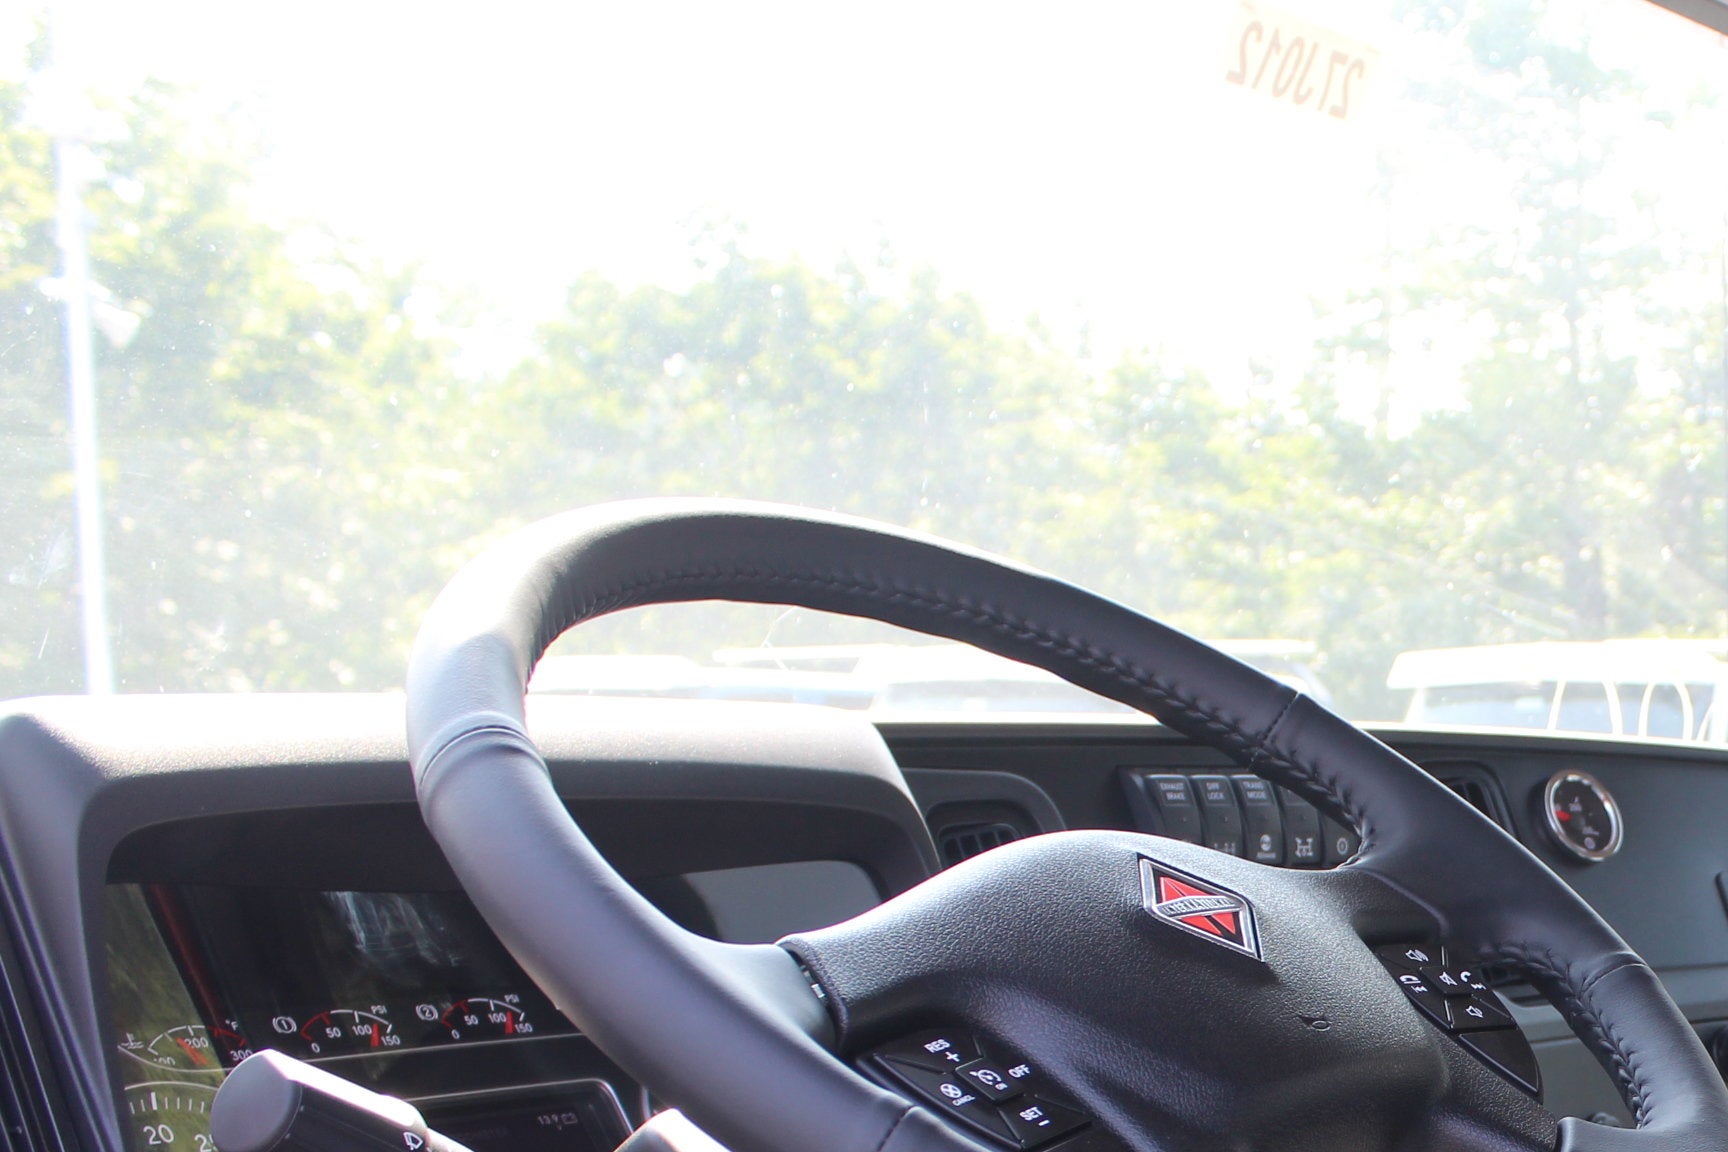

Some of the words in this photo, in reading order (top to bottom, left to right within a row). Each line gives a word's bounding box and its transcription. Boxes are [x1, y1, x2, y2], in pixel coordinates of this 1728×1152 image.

[504, 994, 519, 1003] PSI
[371, 1005, 388, 1014] PSI
[464, 1015, 478, 1025] 50
[488, 1013, 507, 1023] 100
[326, 1027, 341, 1038] 50
[352, 1024, 372, 1036] 100
[515, 1023, 533, 1033] 150
[451, 1029, 460, 1039] 0
[381, 1035, 400, 1046] 150
[924, 1039, 950, 1053] RES
[311, 1042, 320, 1053] 0
[1008, 1064, 1030, 1078] OFF
[1020, 1107, 1043, 1121] SET
[143, 1124, 174, 1145] 20
[194, 1133, 215, 1152] 2
